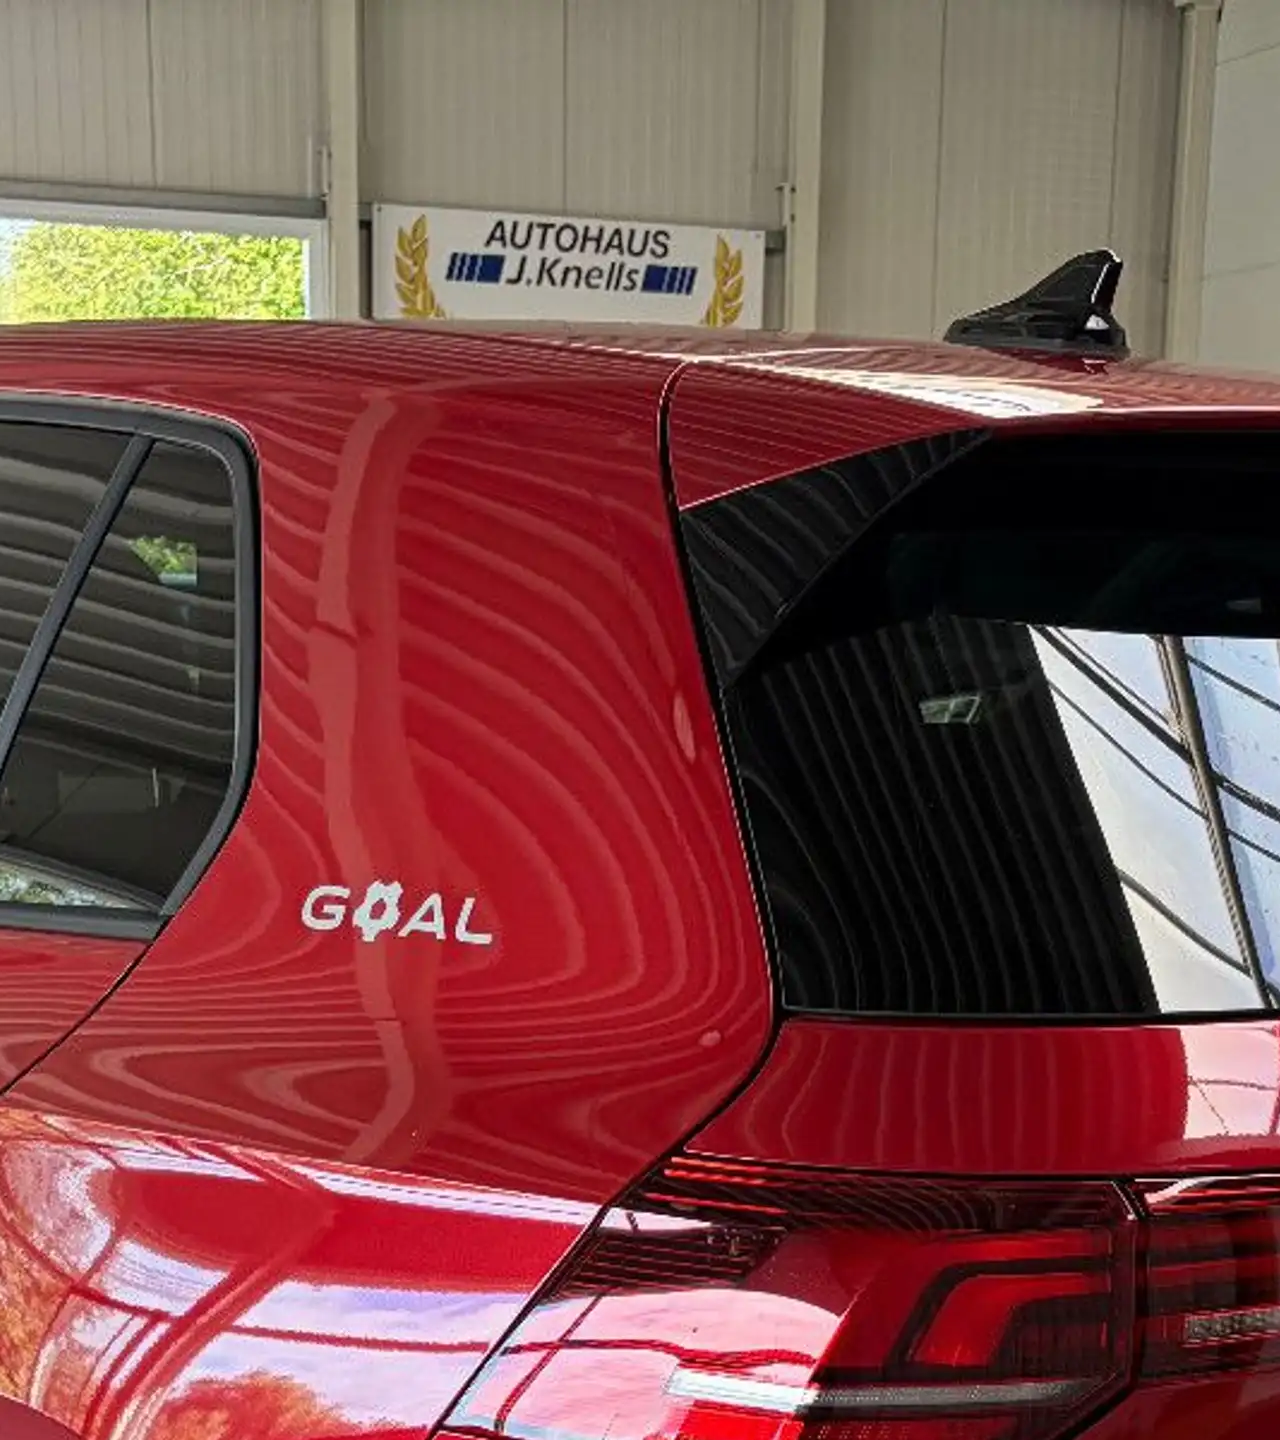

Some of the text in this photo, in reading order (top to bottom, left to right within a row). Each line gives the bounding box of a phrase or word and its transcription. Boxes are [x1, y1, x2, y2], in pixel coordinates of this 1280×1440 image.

[485, 220, 671, 257] AUTOHAUS
[505, 255, 640, 292] J.Knells
[301, 879, 492, 944] GOAL
